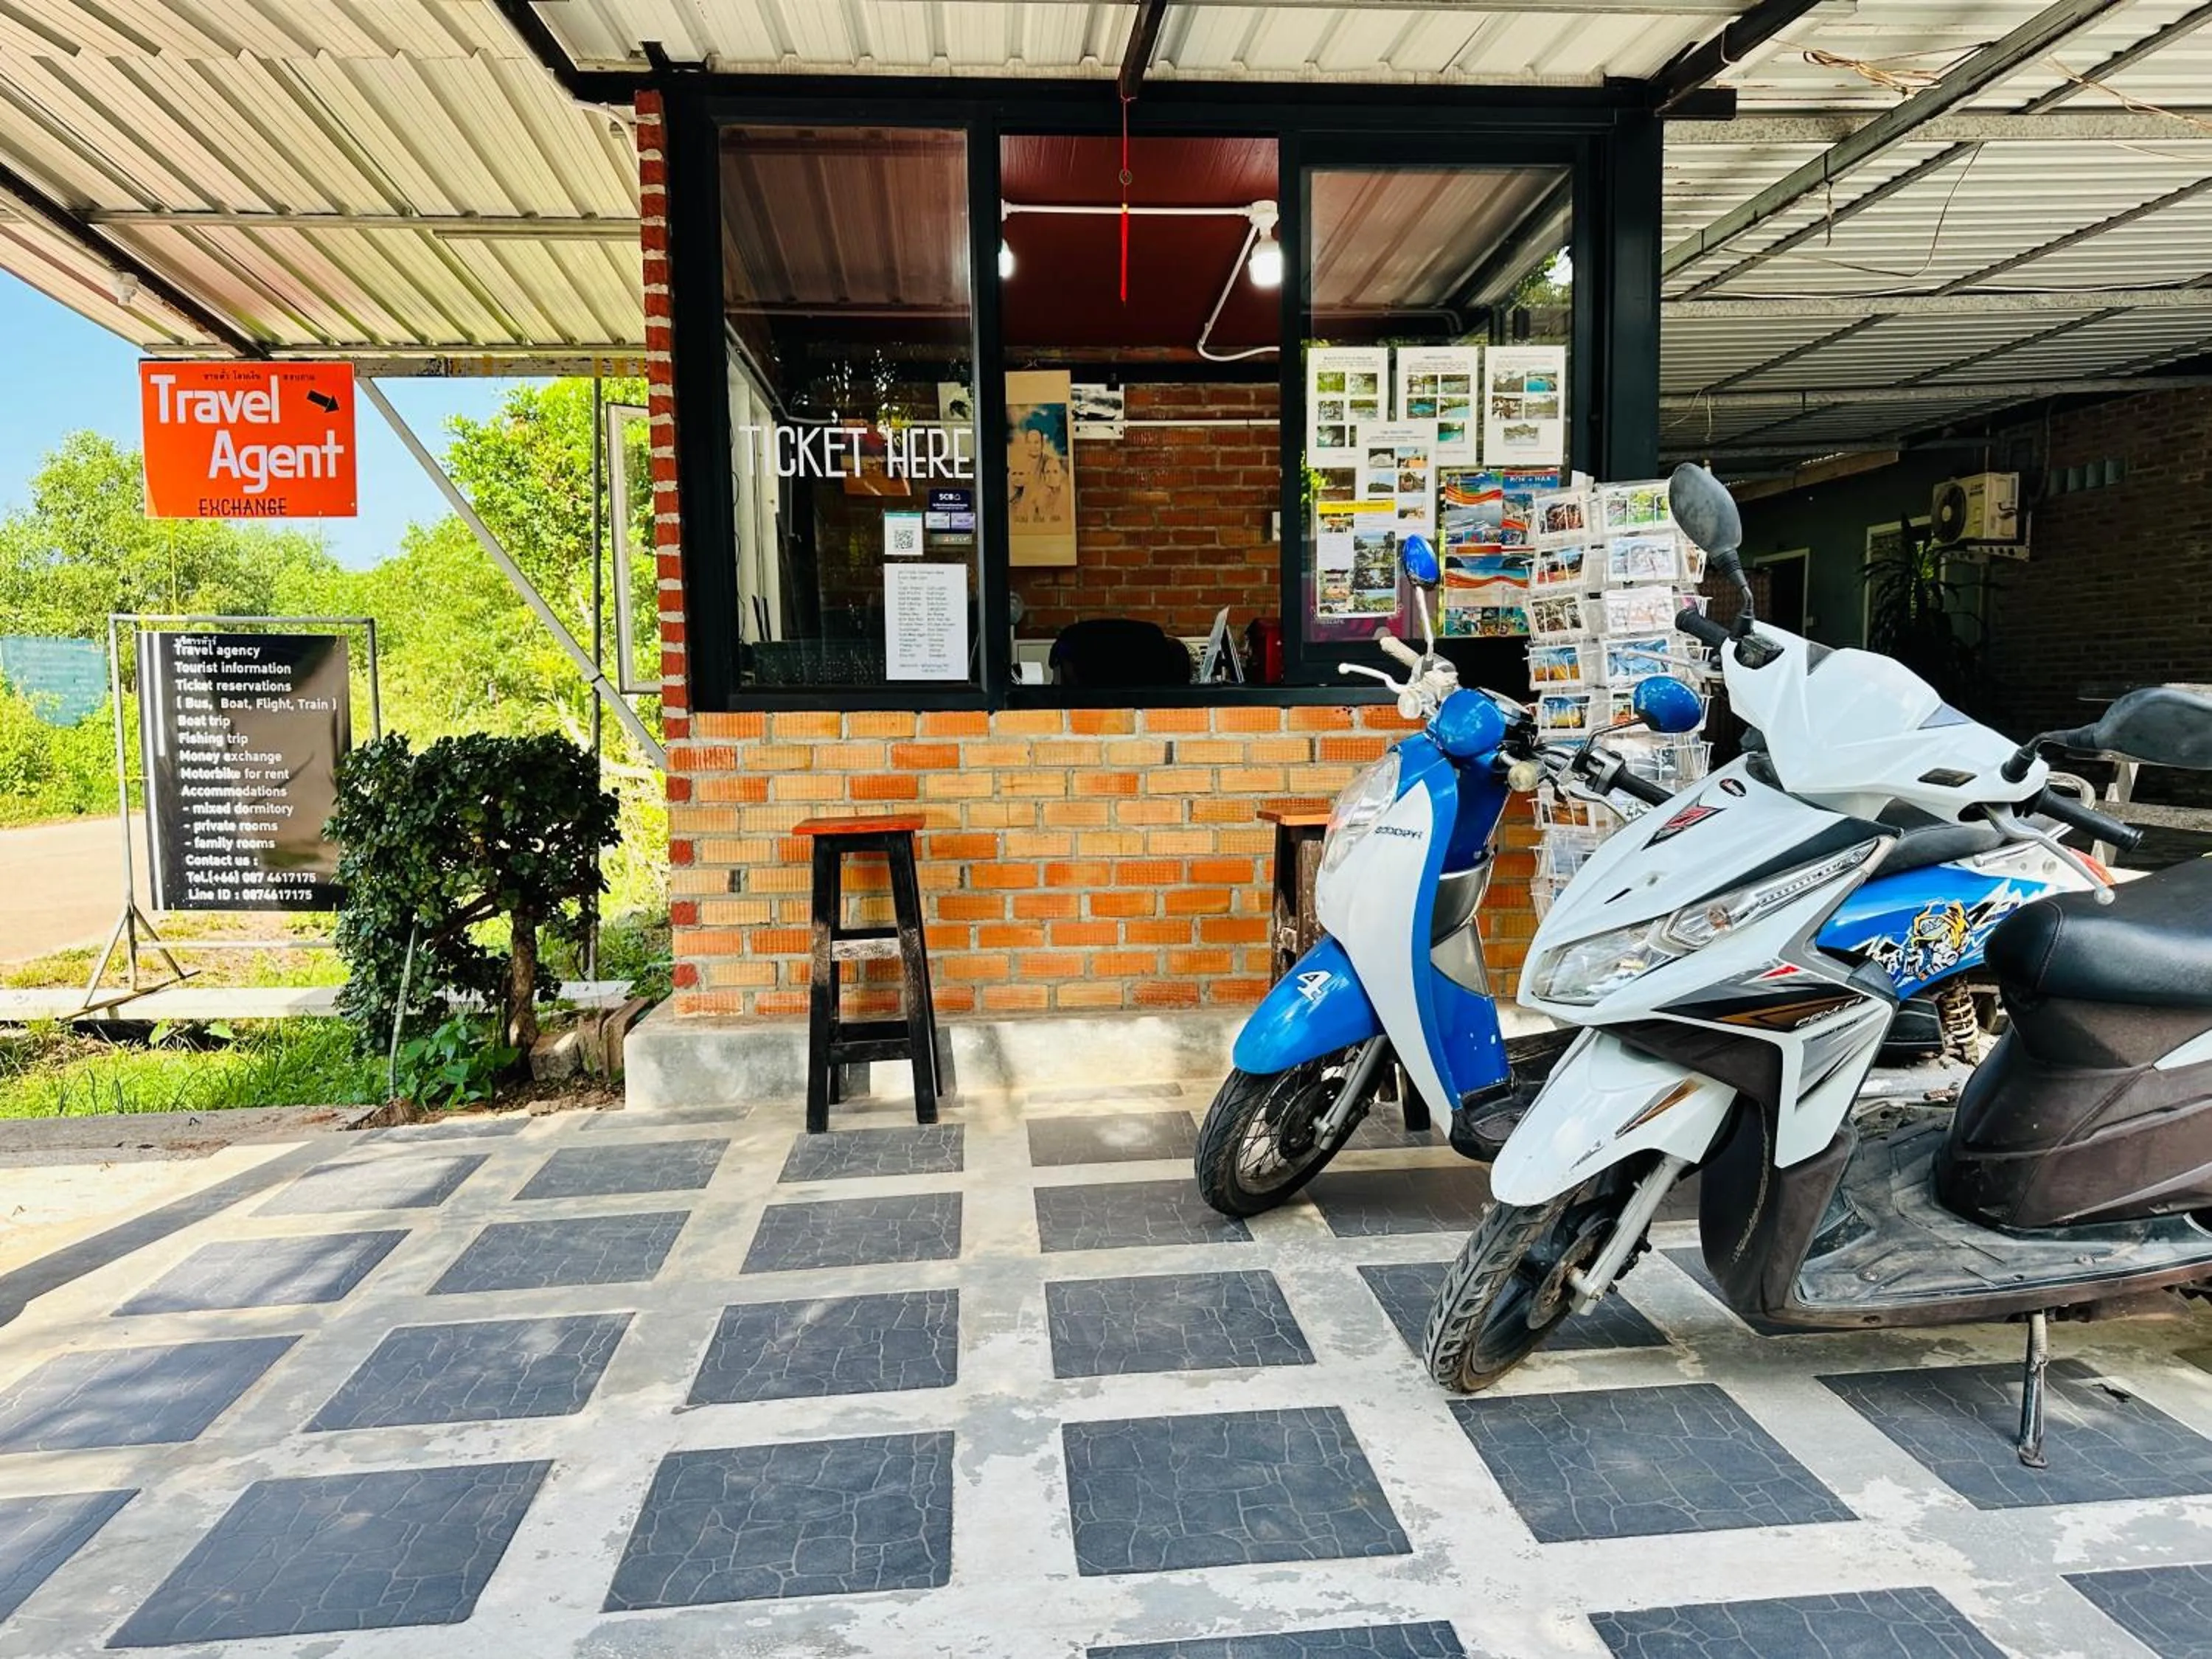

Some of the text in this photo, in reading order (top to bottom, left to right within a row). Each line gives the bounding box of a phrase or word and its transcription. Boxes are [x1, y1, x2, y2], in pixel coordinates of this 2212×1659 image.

[150, 375, 280, 423] Travel
[739, 425, 974, 479] TICKET HERE
[209, 430, 344, 493] Agent
[199, 498, 287, 516] EXCHANGE
[173, 644, 260, 658] Travel agency
[173, 662, 291, 674] Tourist information
[175, 680, 292, 692] Ticket reservations
[221, 698, 252, 710] Boat,
[256, 698, 294, 712] Flight,
[297, 698, 328, 710] Train
[177, 715, 231, 728] Boat trip
[178, 732, 248, 746] Fishing trip
[179, 751, 282, 764] Money exchange
[181, 768, 290, 779] Motorbike for rent
[181, 785, 288, 797] Accommodations
[193, 802, 231, 814] mixed
[234, 803, 294, 816] dormitory
[193, 820, 236, 834] private
[239, 822, 278, 832] rooms
[194, 837, 234, 851] family
[236, 839, 275, 849] rooms
[185, 855, 232, 866] Contact
[234, 857, 250, 866] us
[242, 872, 264, 883] 087
[267, 872, 316, 883] 4617175
[188, 888, 214, 900] Line
[218, 889, 231, 900] ID
[243, 888, 313, 900] 0874617175
[1297, 970, 1332, 1001] 4
